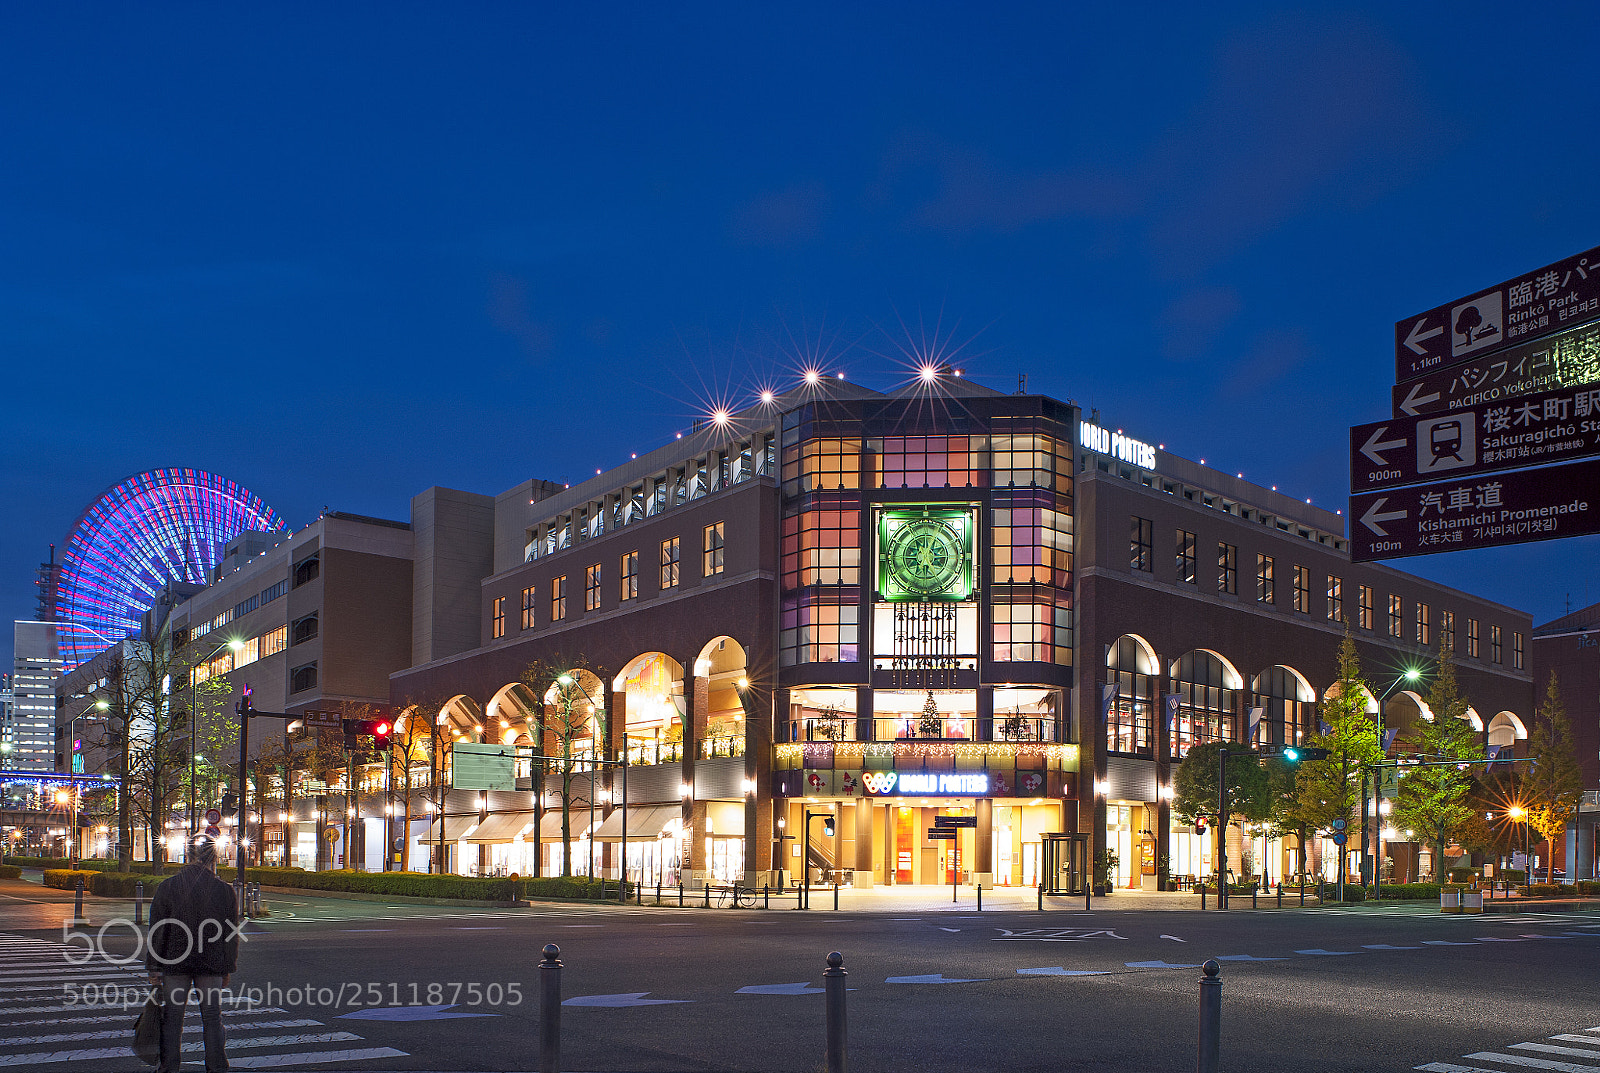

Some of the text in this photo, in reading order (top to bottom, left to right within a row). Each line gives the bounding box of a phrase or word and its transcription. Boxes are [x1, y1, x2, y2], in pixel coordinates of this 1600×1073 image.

[1549, 291, 1579, 310] Park
[1410, 354, 1442, 372] 1.1km
[1449, 387, 1500, 410] PACIFICO
[1482, 388, 1600, 434] 桜木町駅
[1111, 431, 1156, 471] PORTERS
[1368, 469, 1402, 482] 900m
[1418, 481, 1504, 517] 汽車道
[1418, 499, 1589, 532] Kishamichi Promenade
[1369, 541, 1402, 553] 190m
[1418, 530, 1464, 546] 火车大道
